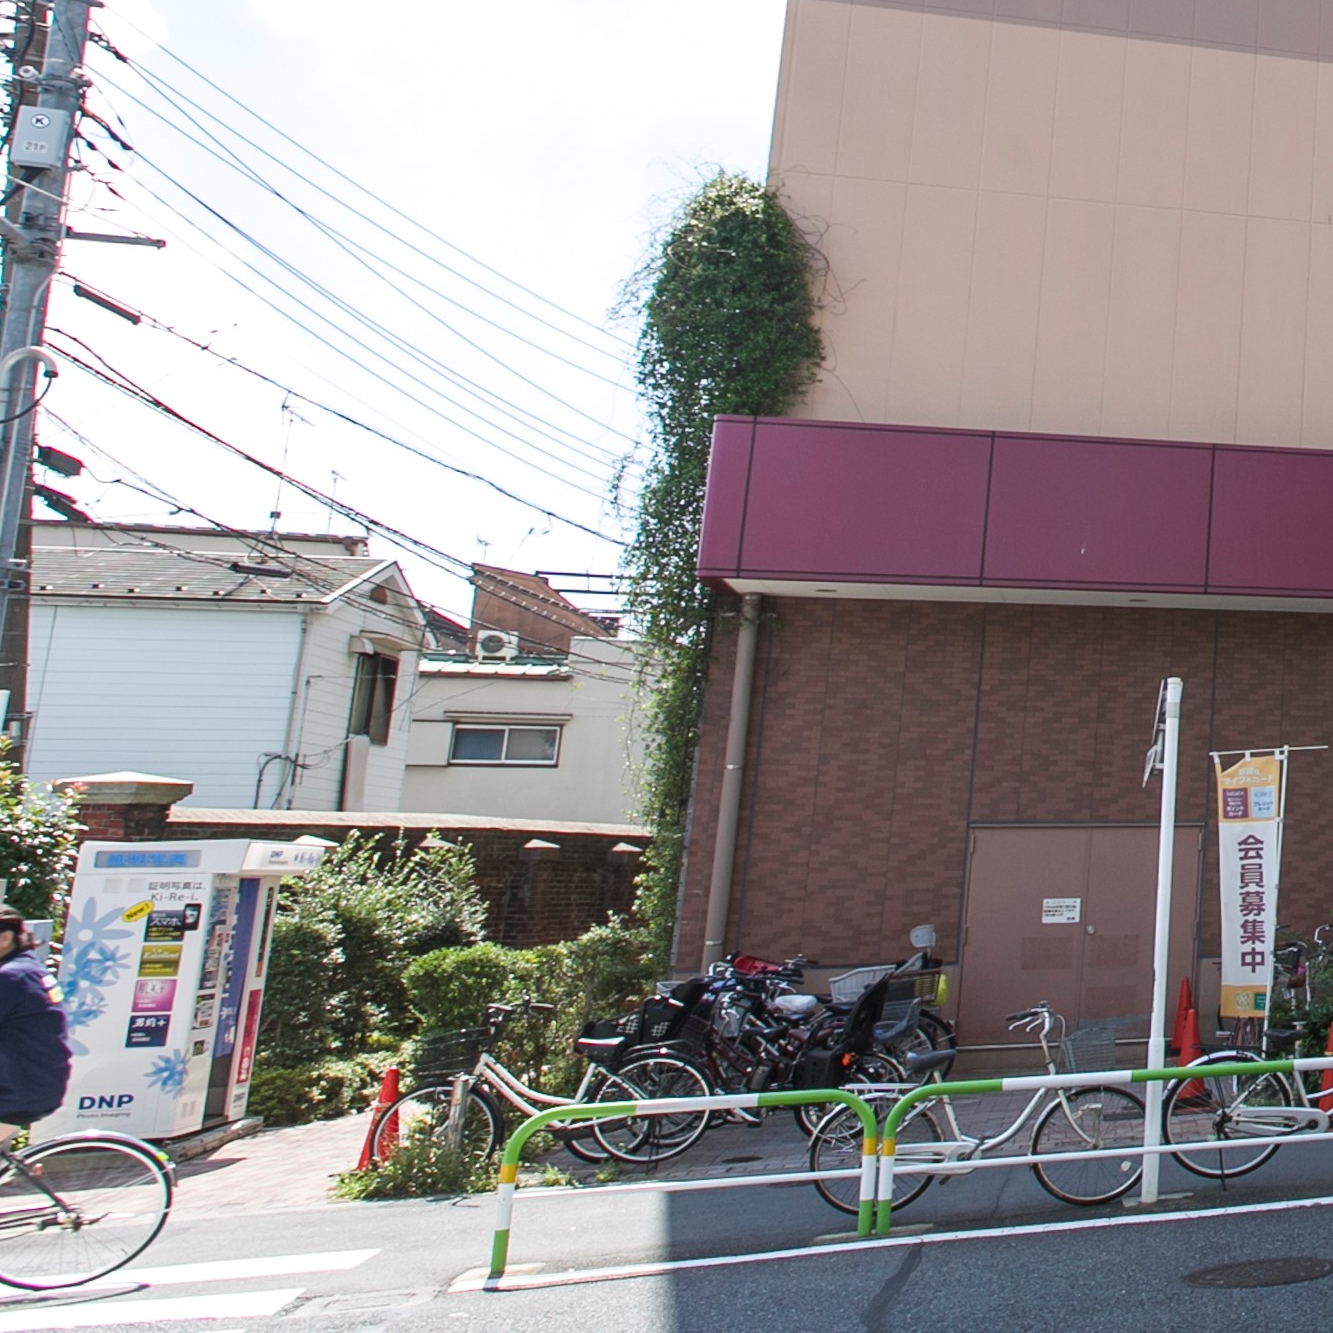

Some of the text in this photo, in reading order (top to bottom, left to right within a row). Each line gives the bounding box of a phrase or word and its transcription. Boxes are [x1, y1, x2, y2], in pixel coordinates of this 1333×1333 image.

[1237, 833, 1266, 974] 会員募集中
[78, 1094, 135, 1110] DNP
